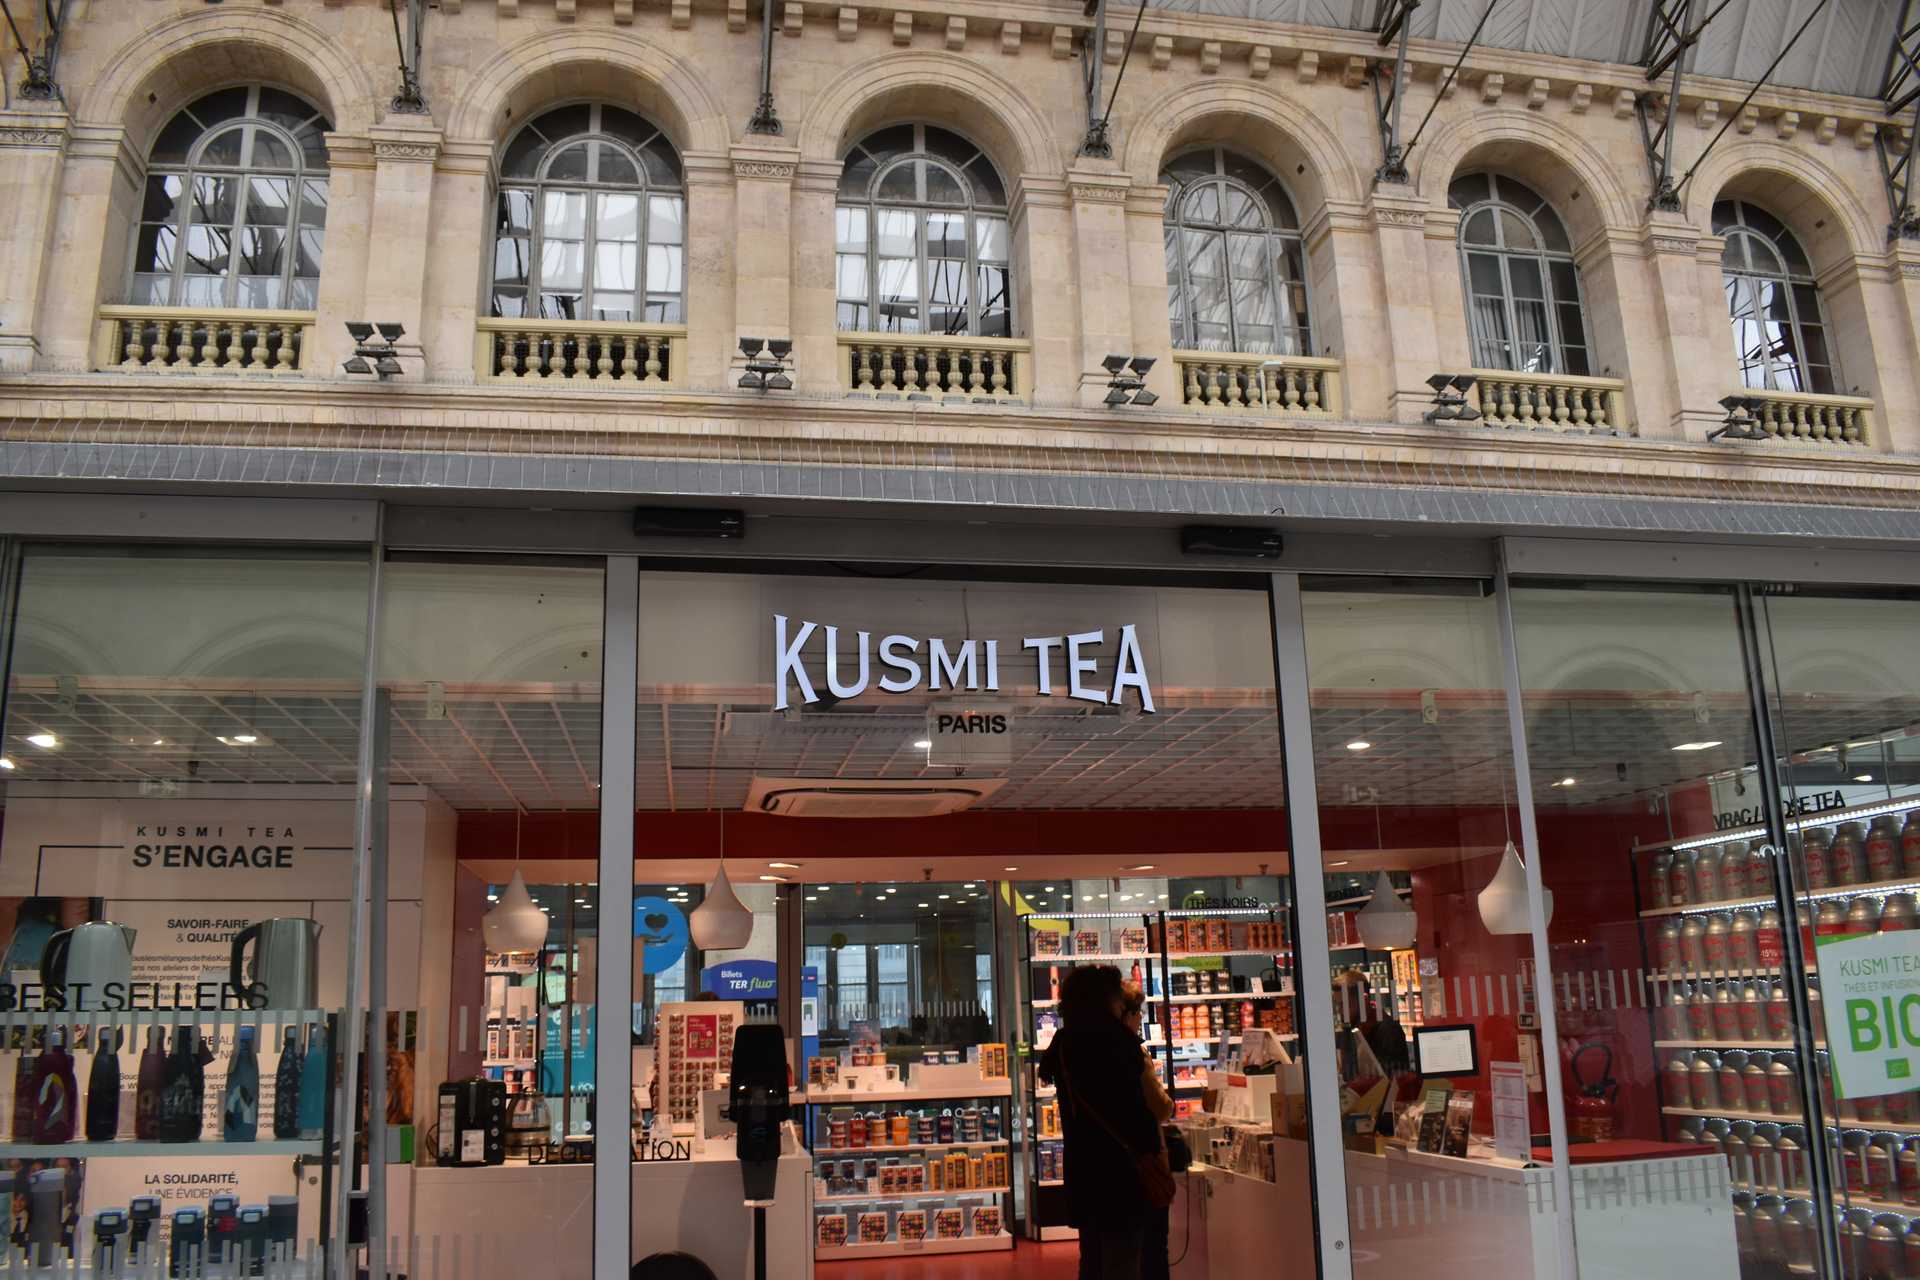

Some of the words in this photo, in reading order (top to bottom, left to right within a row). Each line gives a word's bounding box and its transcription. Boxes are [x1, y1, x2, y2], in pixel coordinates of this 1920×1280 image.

[773, 614, 999, 711] KUSMI
[1022, 623, 1156, 714] TEA
[938, 714, 1007, 735] PARIS
[1811, 789, 1846, 812] TEA
[137, 826, 223, 837] KUSMI
[248, 827, 294, 838] TEA
[132, 844, 294, 869] S'ENGAGE
[167, 918, 249, 929] SAVOIR-FAIRE
[1840, 957, 1888, 976] KUSMI
[730, 980, 747, 989] TER
[747, 977, 775, 992] fluo
[0, 982, 91, 1013] BEST
[101, 982, 269, 1013] SELLERS
[145, 1174, 160, 1184] LA
[163, 1171, 239, 1185] SOLIDARITÉ,
